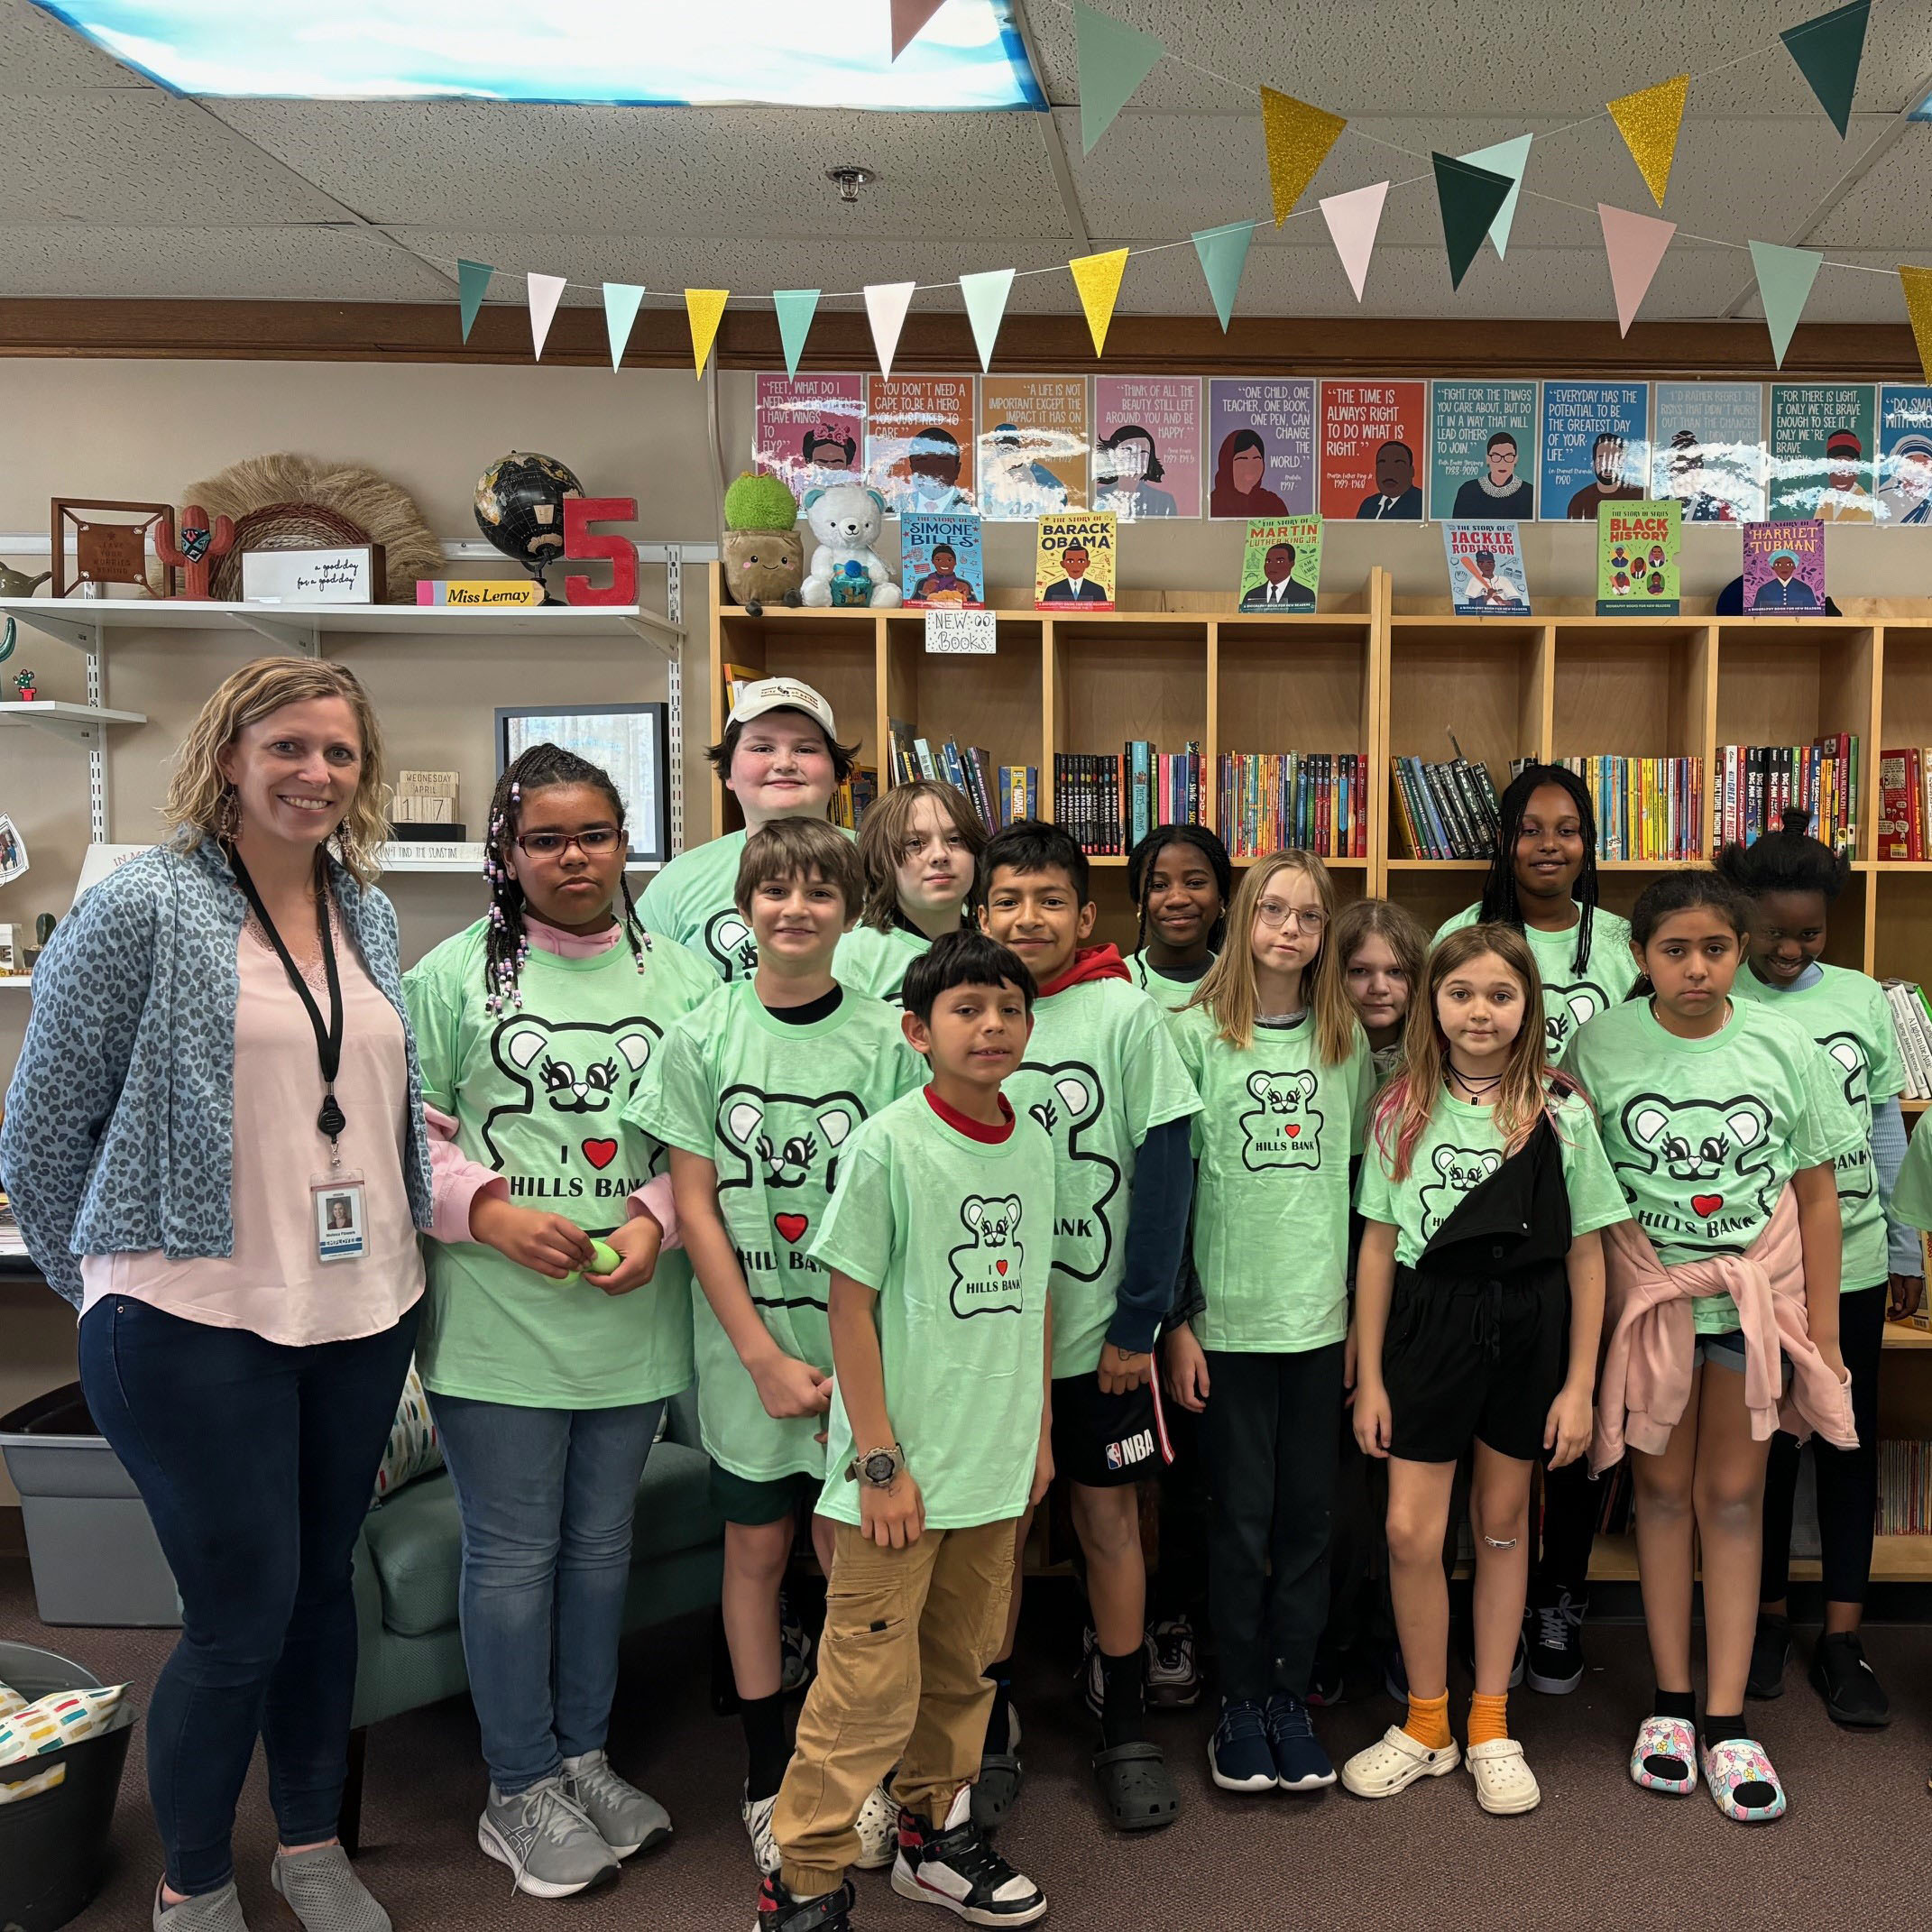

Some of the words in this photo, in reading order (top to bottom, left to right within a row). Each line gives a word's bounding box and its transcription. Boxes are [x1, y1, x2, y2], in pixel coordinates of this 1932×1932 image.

[795, 382, 818, 394] WHAT
[822, 382, 833, 393] DO
[837, 382, 839, 393] I
[903, 383, 932, 396] DON’T
[934, 384, 955, 396] NEED
[959, 383, 965, 396] A
[1293, 387, 1311, 399] ONE
[1359, 389, 1382, 403] TIME
[1385, 390, 1394, 404] IS
[1468, 389, 1484, 400] FOR
[1486, 389, 1500, 400] THE
[1504, 390, 1532, 401] THINGS
[1602, 391, 1618, 403] HAS
[1622, 391, 1637, 403] THE
[1801, 391, 1824, 402] THERE
[1826, 391, 1834, 402] IS
[875, 397, 897, 409] CAPE
[901, 398, 911, 409] TO
[915, 399, 924, 410] BE
[927, 398, 934, 410] A
[936, 399, 961, 410] HERO.
[1223, 400, 1261, 413] TEACHER,
[1265, 400, 1281, 411] ONE
[1283, 400, 1310, 413] BOOK,
[1438, 402, 1451, 412] YOU
[1454, 402, 1473, 413] CARE
[1476, 403, 1502, 414] ABOUT,
[1504, 403, 1518, 413] BUT
[1521, 403, 1531, 414] DO
[1777, 404, 1783, 415] IF
[1786, 404, 1806, 415] ONLY
[1836, 404, 1861, 415] BRAVE
[1328, 406, 1366, 421] ALWAYS
[1370, 407, 1399, 421] RIGHT
[1549, 404, 1594, 417] POTENTIAL
[1597, 405, 1607, 418] TO
[1611, 405, 1621, 418] BE
[1251, 414, 1267, 426] ONE
[1292, 414, 1310, 426] CAN
[1438, 415, 1444, 426] IT
[1448, 415, 1455, 427] IN
[1458, 416, 1464, 427] A
[1467, 416, 1484, 427] WAY
[1488, 416, 1507, 428] THAT
[1510, 416, 1528, 428] WILL
[1549, 419, 1564, 431] THE
[1568, 419, 1611, 432] GREATEST
[1615, 420, 1631, 432] DAY
[1276, 428, 1310, 439] CHANGE
[1327, 424, 1339, 438] TO
[1344, 424, 1358, 438] DO
[1363, 424, 1391, 439] WHAT
[1394, 425, 1403, 439] IS
[1438, 428, 1456, 439] LEAD
[1459, 429, 1487, 440] OTHERS
[1549, 434, 1559, 446] OF
[1295, 442, 1310, 454] THE
[1438, 442, 1447, 454] TO
[910, 522, 973, 535] SIMONE
[1043, 523, 1110, 535] BARACK
[1251, 524, 1318, 538] MARTIN
[1610, 519, 1669, 531] BLACK
[1451, 531, 1513, 544] JACKIE
[1610, 531, 1669, 542] HISTORY
[1749, 528, 1818, 540] HARRIET
[911, 535, 973, 547] BILES
[1042, 536, 1110, 550] OBAMA
[1250, 538, 1282, 547] LUTHER
[1751, 539, 1818, 554] TUBMAN
[564, 498, 639, 606] 5
[1452, 544, 1514, 555] ROBINSON
[323, 559, 342, 578] good
[343, 559, 358, 576] day
[319, 573, 338, 592] good
[339, 573, 354, 590] day
[447, 589, 480, 603] Miss
[482, 589, 529, 603] Lemay
[935, 612, 968, 630] NEW
[406, 774, 451, 783] WEDNESDAY
[414, 786, 436, 794] APRIL
[1714, 775, 1722, 811] TRAITORS
[403, 798, 413, 820] 1
[433, 799, 444, 821] 7
[1714, 812, 1722, 834] AMONG
[1714, 836, 1721, 846] US
[1277, 1127, 1279, 1136] I
[1256, 1142, 1287, 1151] HILLS
[1292, 1141, 1314, 1150] BANK
[561, 1145, 567, 1164] I
[511, 1176, 584, 1197] HILLS
[1707, 1214, 1758, 1237] BANK
[989, 1265, 991, 1274] I
[967, 1282, 998, 1293] HILLS
[1121, 1429, 1155, 1465] NBA
